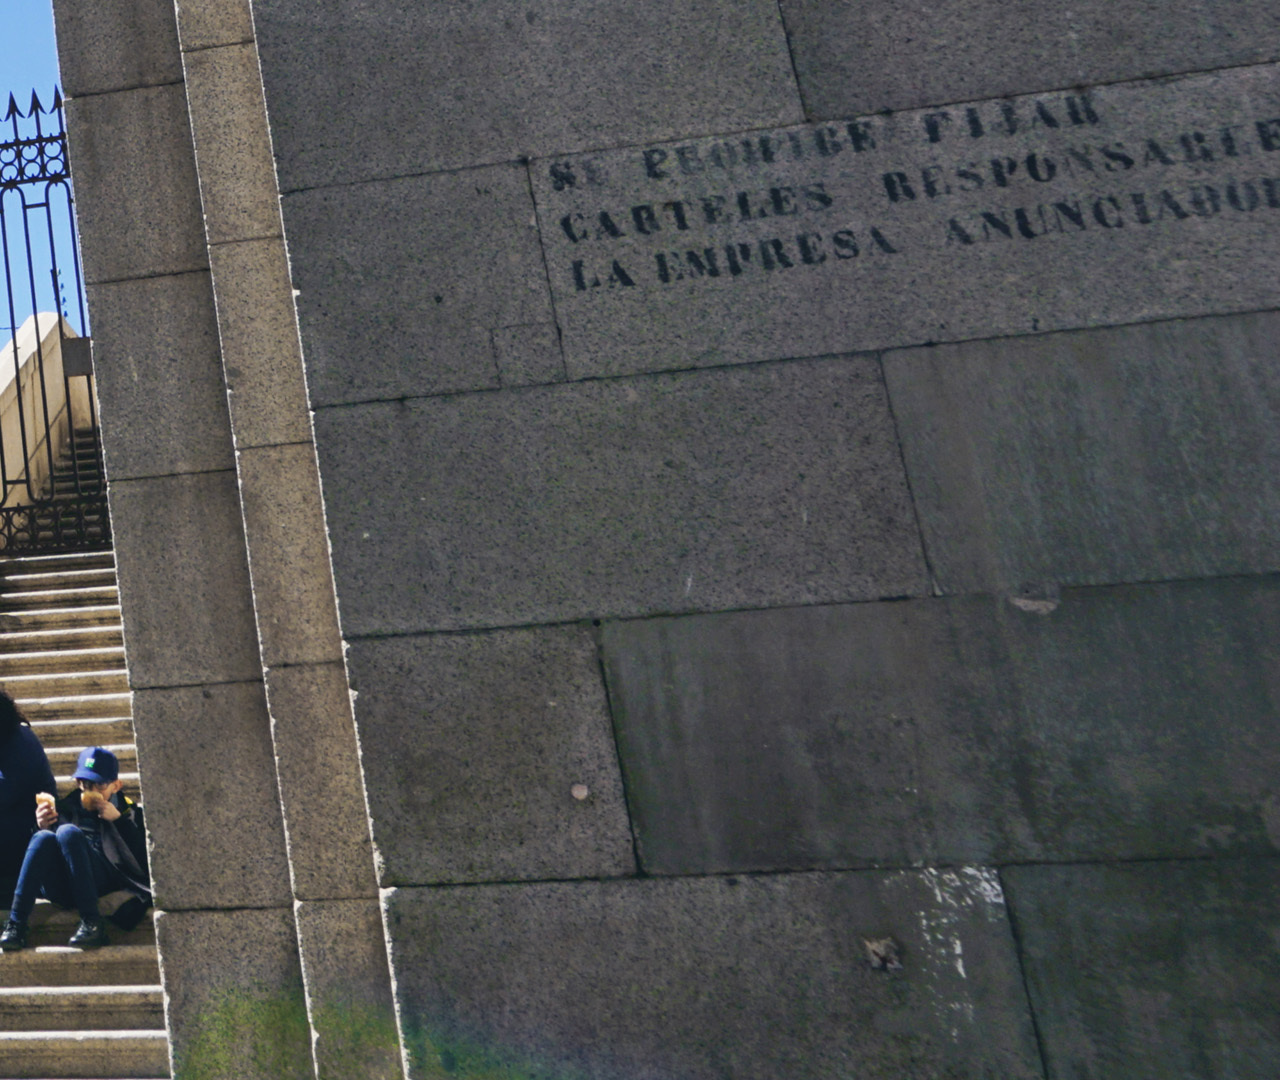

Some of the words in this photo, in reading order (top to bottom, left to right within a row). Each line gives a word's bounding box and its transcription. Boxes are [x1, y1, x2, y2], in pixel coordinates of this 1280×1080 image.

[560, 182, 833, 244] CARTELES
[572, 259, 636, 291] LA
[654, 226, 897, 283] EMPRESA
